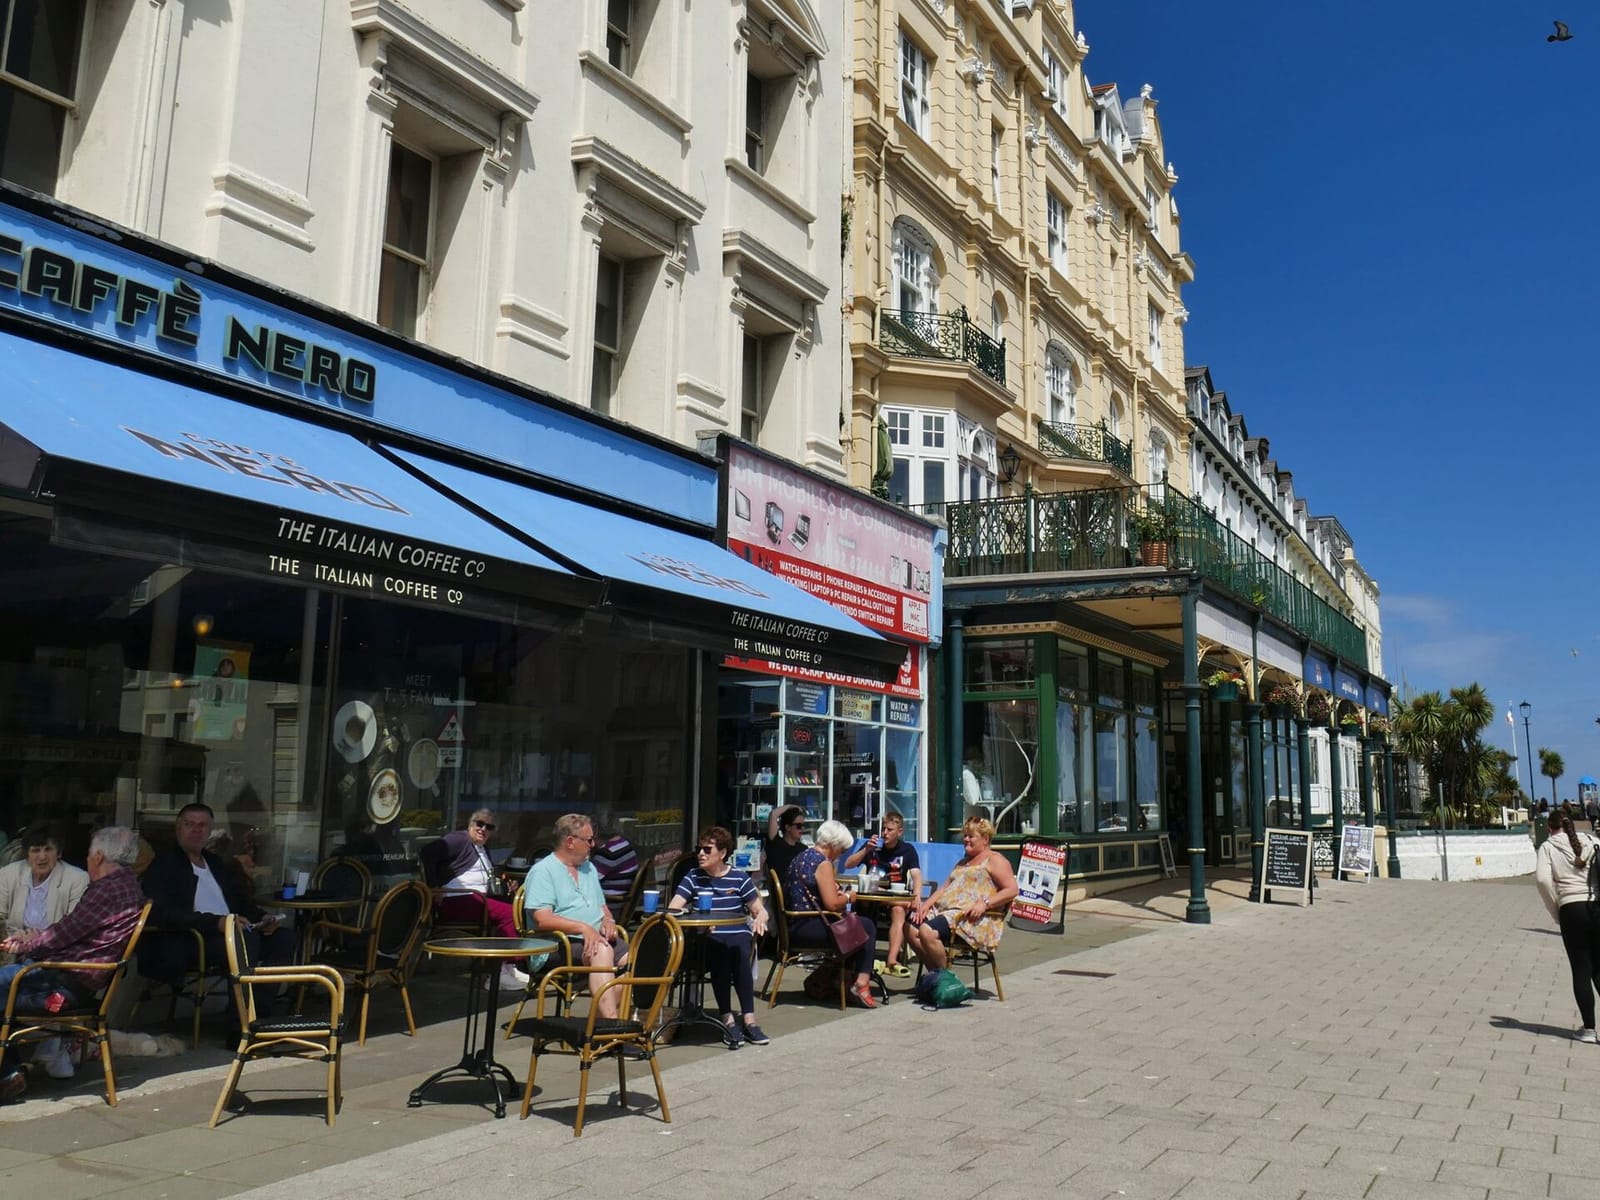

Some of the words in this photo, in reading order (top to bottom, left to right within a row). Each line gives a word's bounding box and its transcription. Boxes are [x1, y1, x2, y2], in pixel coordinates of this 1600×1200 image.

[223, 314, 376, 403] NERO
[119, 425, 412, 516] NERO
[277, 517, 315, 543] THE
[318, 527, 394, 560] ITALIAN
[398, 545, 461, 574] COFFEE
[269, 555, 300, 576] THE
[315, 563, 373, 588] ITALIAN
[384, 577, 438, 600] COFFEE
[780, 560, 799, 575] WATCH
[800, 566, 821, 581] REPAIRS
[826, 574, 843, 588] PHONE
[844, 580, 863, 594] REPAIRS
[868, 588, 897, 605] ACCESSORIES
[811, 582, 829, 597] LAPTOP
[834, 589, 841, 598] PC
[841, 592, 856, 604] REPAIR
[862, 598, 872, 609] CALL
[873, 601, 882, 611] OUT
[885, 606, 895, 615] VAPE
[908, 600, 920, 611] APPLE
[731, 611, 749, 627] THE
[750, 615, 785, 634] ITALIAN
[786, 624, 817, 641] COFFEE
[858, 609, 876, 622] SWITCH
[877, 615, 894, 628] REPAIRS
[903, 622, 927, 635] SPECIALIST
[734, 638, 749, 650] THE
[754, 642, 781, 657] ITALIAN
[785, 648, 810, 663] COFFEE
[406, 674, 432, 687] MEET
[890, 701, 908, 712] WATCH
[890, 711, 910, 723] REPAIRS
[793, 730, 811, 742] OPEN
[1037, 846, 1066, 858] MOBILES
